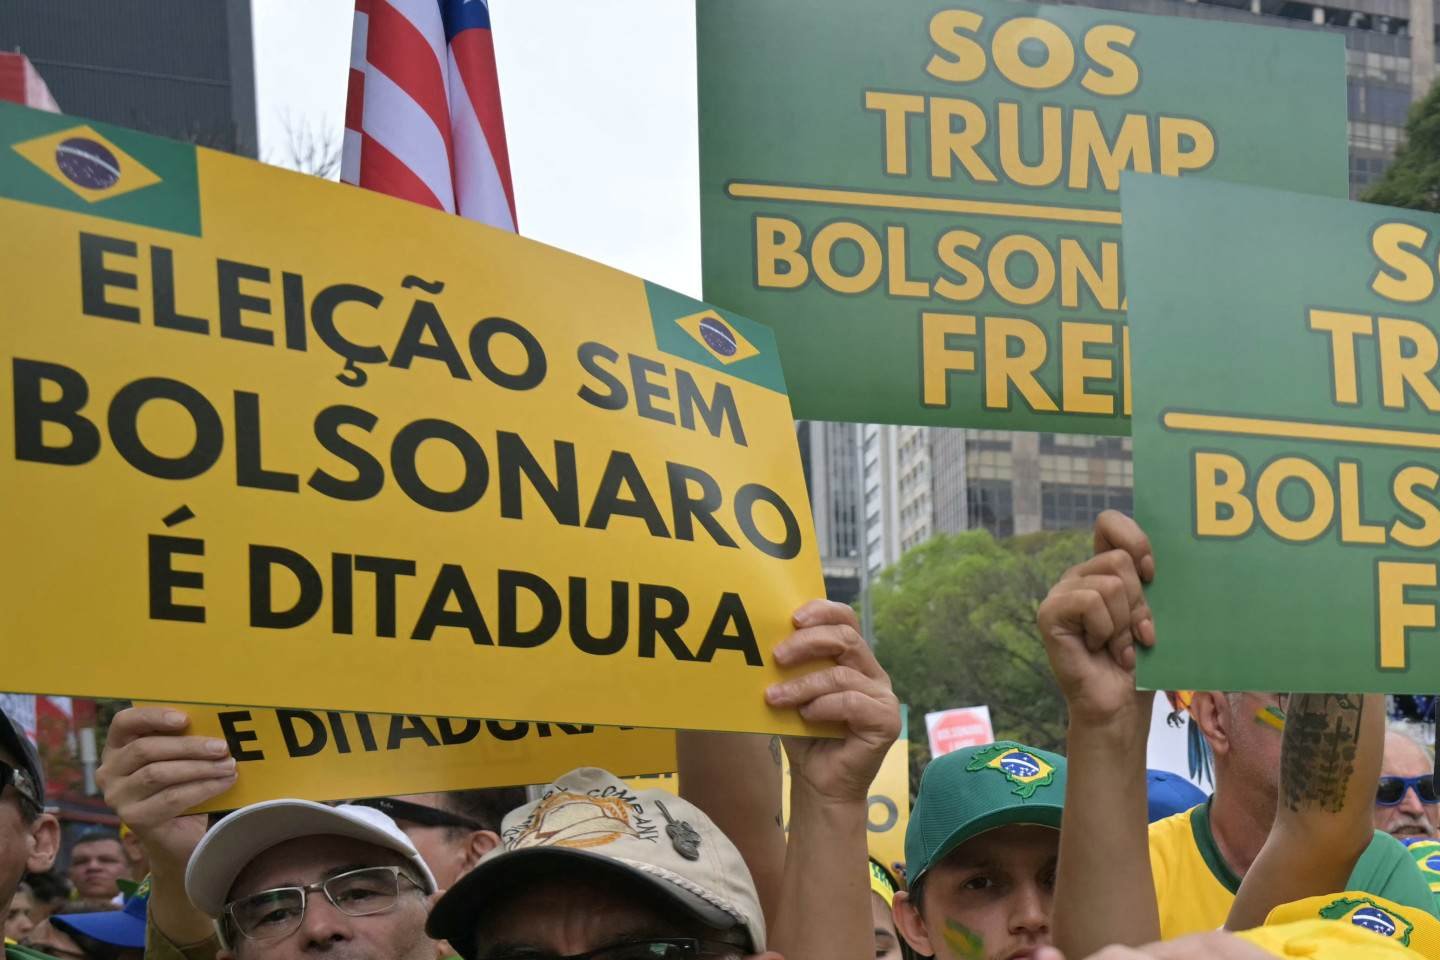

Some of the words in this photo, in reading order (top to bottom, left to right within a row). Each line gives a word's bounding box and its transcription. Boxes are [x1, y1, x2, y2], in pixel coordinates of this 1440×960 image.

[927, 10, 1139, 95] SOS
[866, 91, 1215, 192] TRUMP
[756, 216, 1128, 311] BOLSON
[79, 232, 548, 391] ELEIÇÃO
[576, 341, 748, 447] SEM
[922, 312, 1132, 416] FRE
[13, 357, 803, 561] BOLSONARO
[148, 504, 206, 624] É
[248, 544, 765, 668] DITADURA
